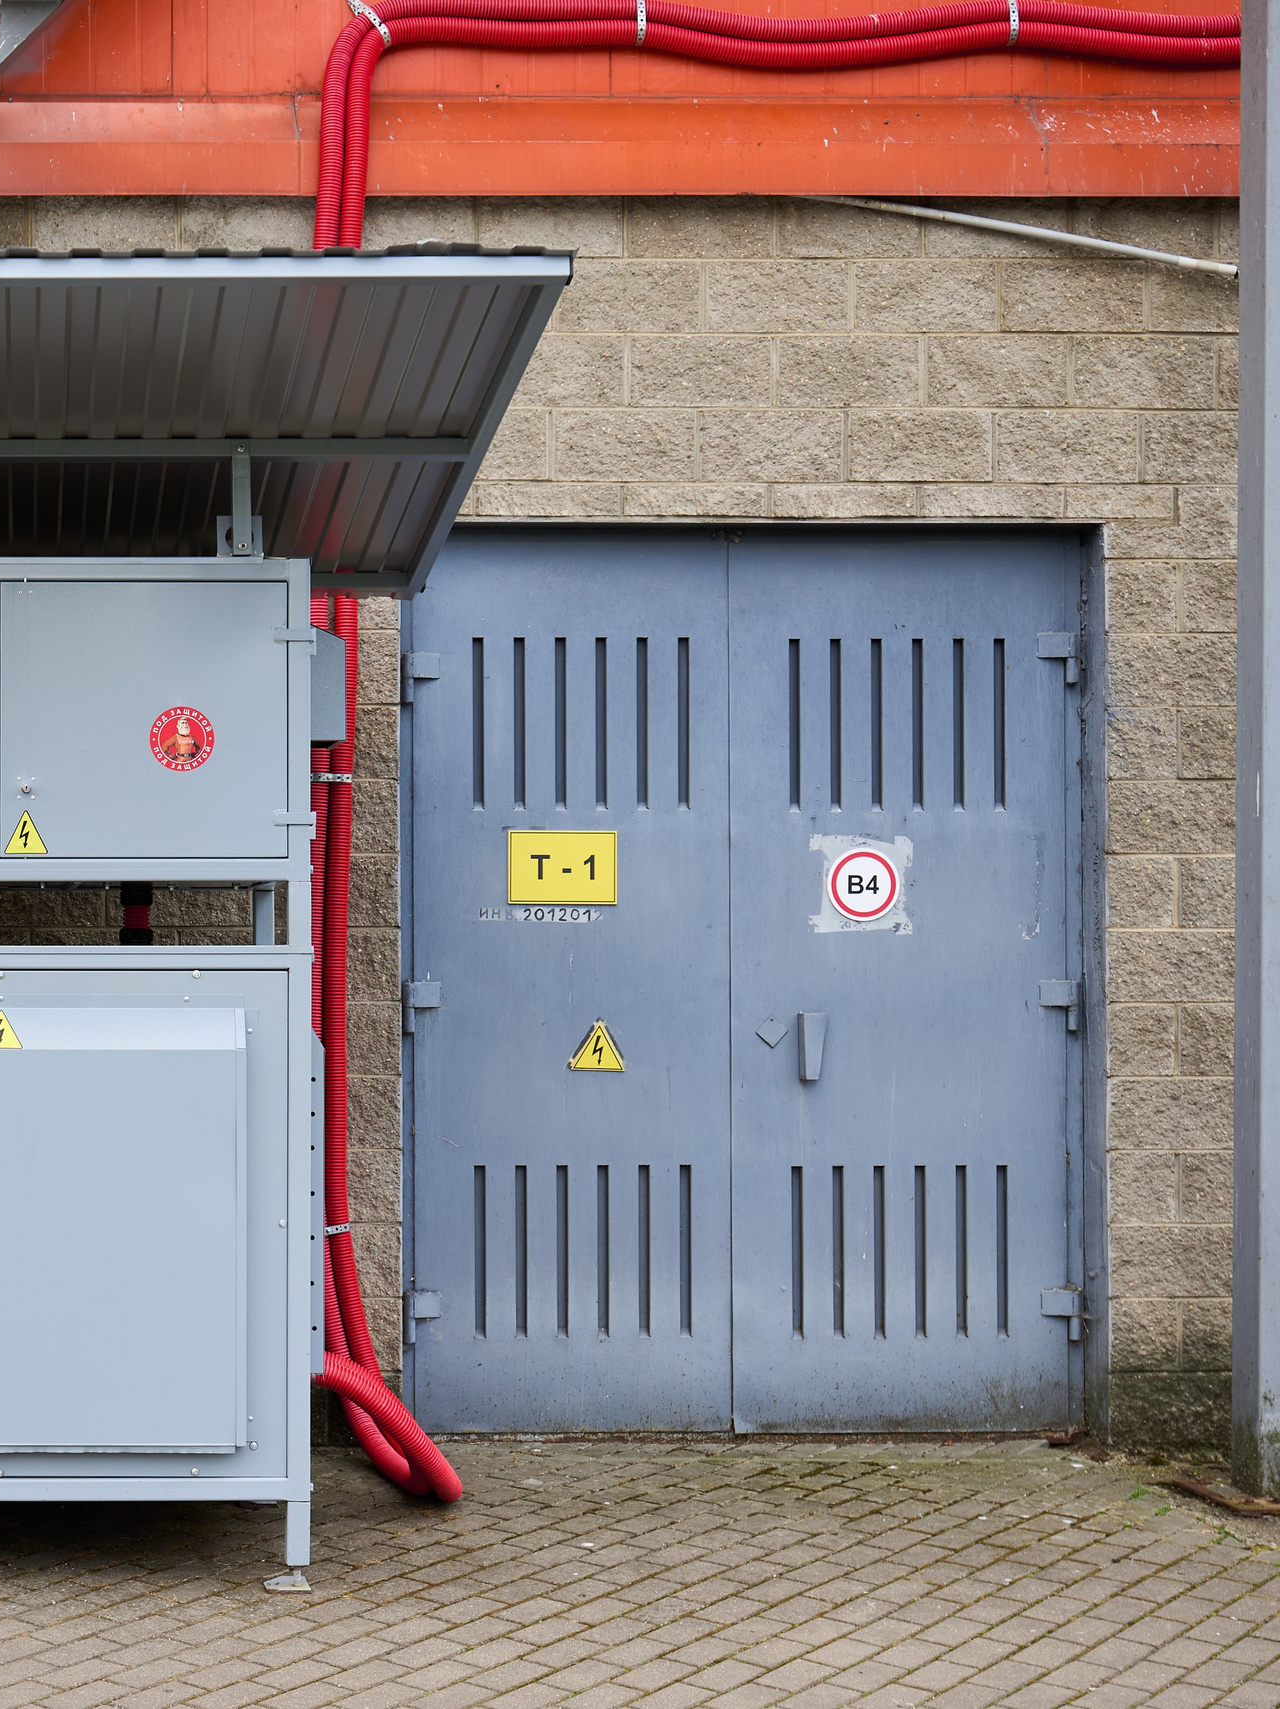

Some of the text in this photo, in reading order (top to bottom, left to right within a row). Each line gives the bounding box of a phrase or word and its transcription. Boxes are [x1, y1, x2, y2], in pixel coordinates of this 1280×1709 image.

[152, 708, 213, 733] ПОД ЗАЩИТОЙ
[153, 746, 212, 770] ПОД ЗАЩИТОЙ
